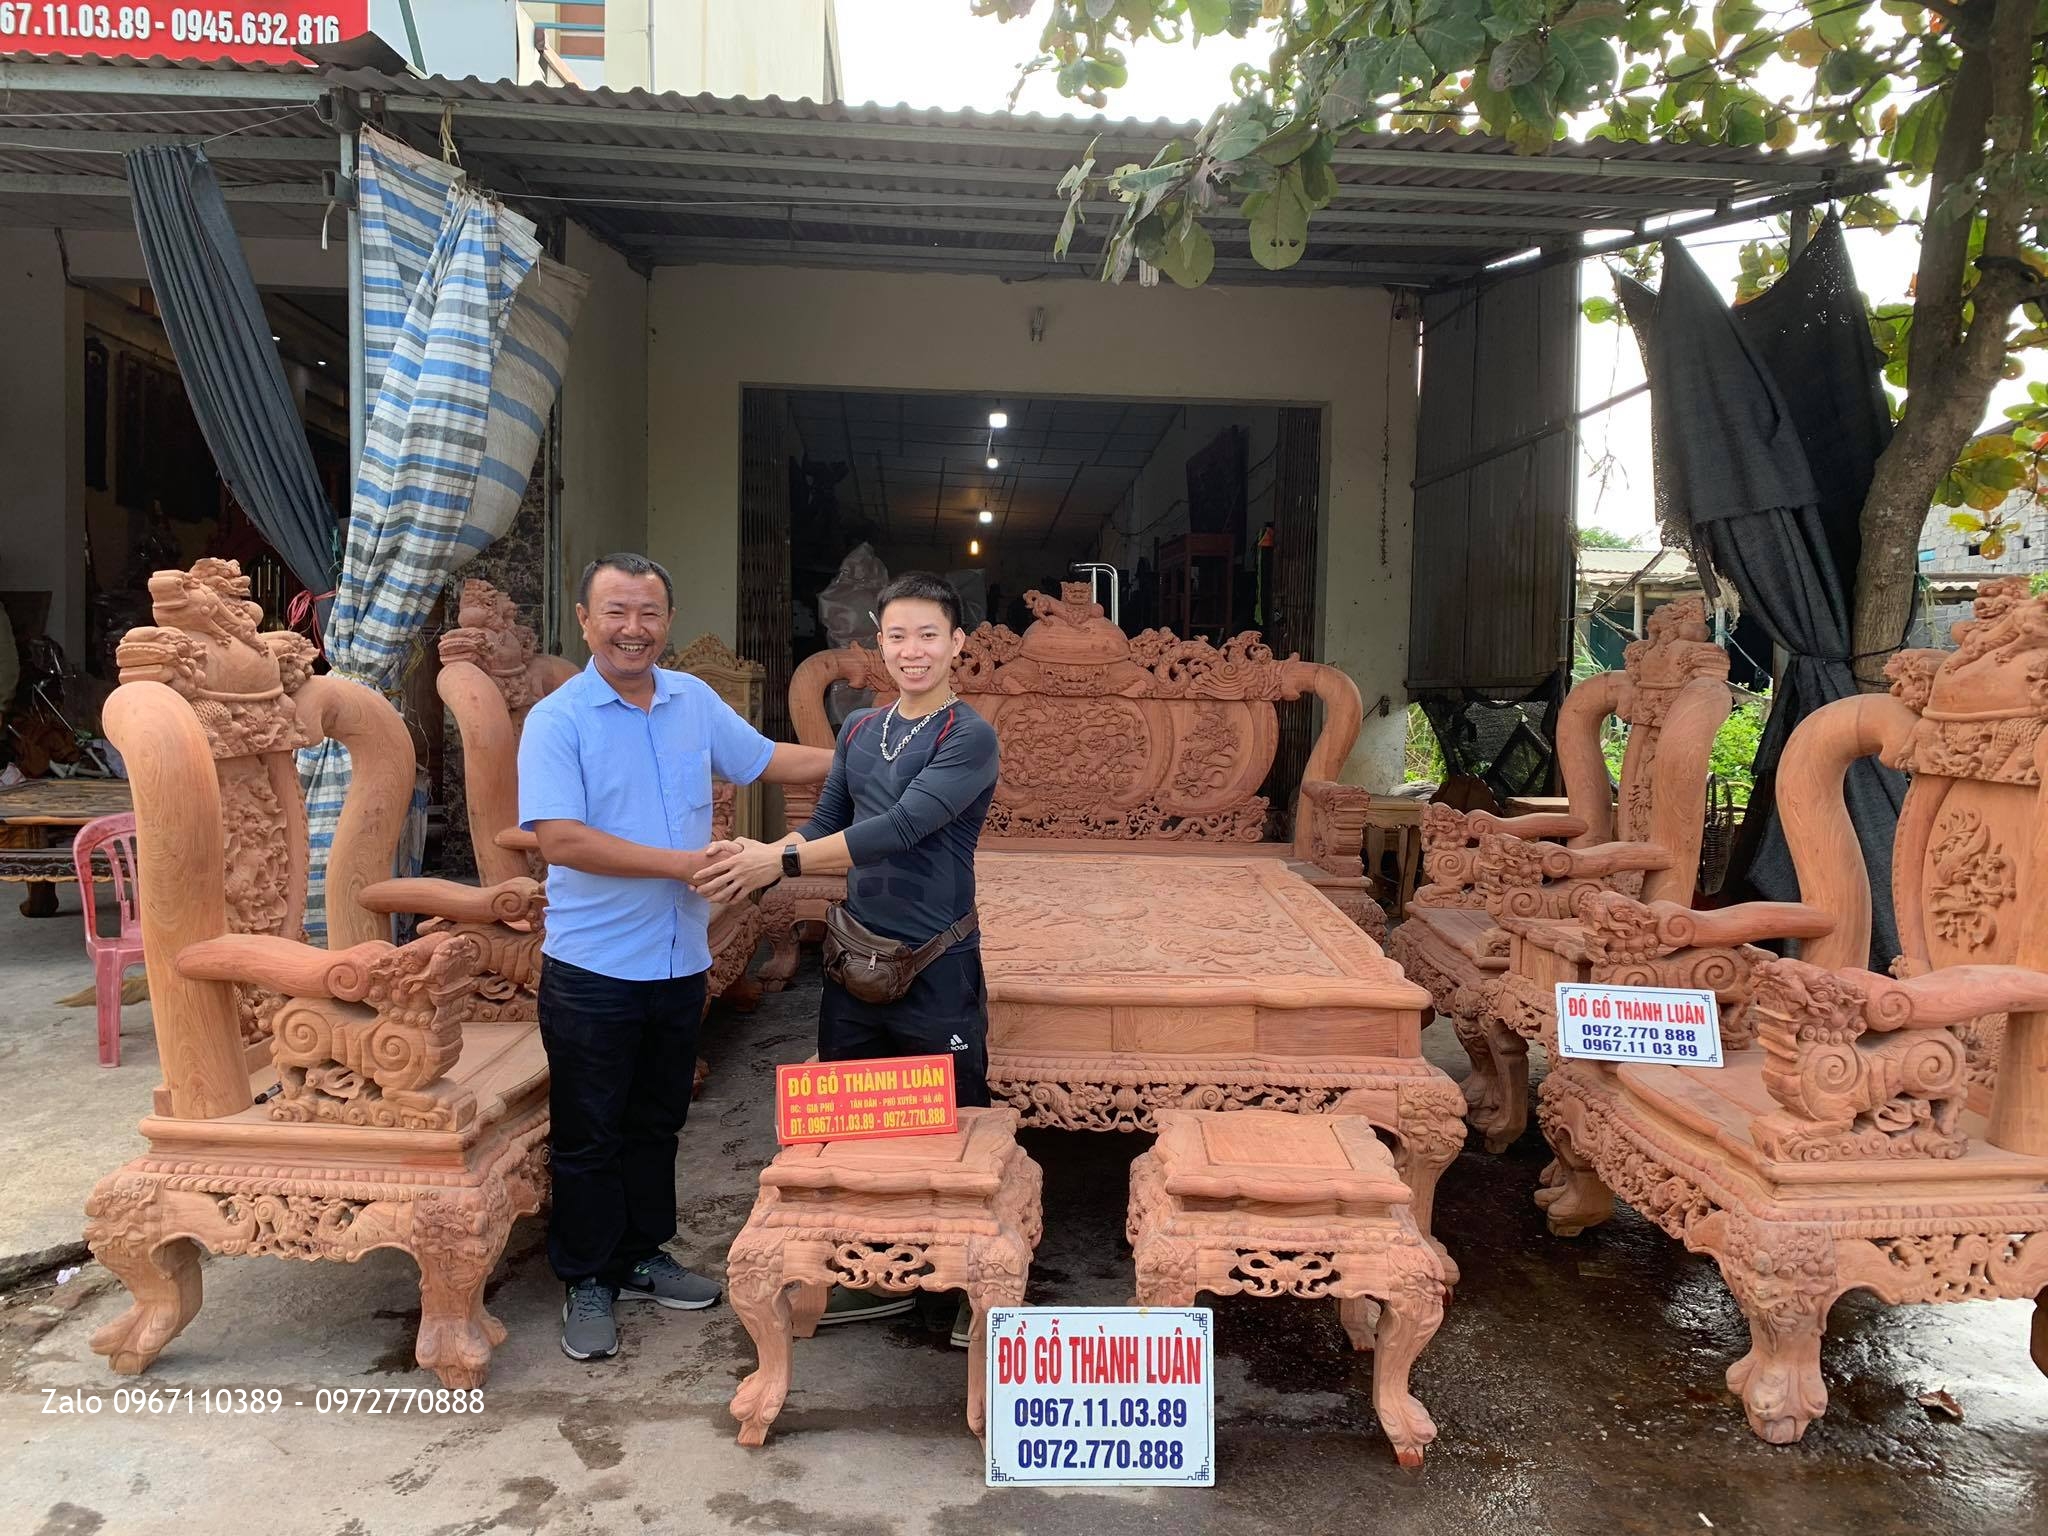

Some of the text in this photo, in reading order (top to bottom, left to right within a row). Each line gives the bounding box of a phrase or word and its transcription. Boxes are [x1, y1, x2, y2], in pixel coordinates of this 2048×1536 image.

[0, 1, 150, 39] 67.11.03.89
[171, 8, 340, 45] 0945.632.816
[1569, 992, 1705, 1025] ĐỒ GỖ THÀNH LUÂN
[1582, 1024, 1696, 1042] 0972.770 888
[1583, 1038, 1698, 1057] 0967.11 03 89
[788, 1064, 945, 1097] ĐỒ GỖ THÀNH LUÂN
[790, 1117, 806, 1136] ĐT:
[808, 1112, 875, 1134] 0967.11.03.89
[883, 1107, 946, 1128] 0972.770.888
[998, 1318, 1201, 1385] ĐỒ GỖ THÀNH LUÂN
[1014, 1398, 1187, 1428] 0967.11.03.89
[1018, 1439, 1184, 1470] 0972.770.888
